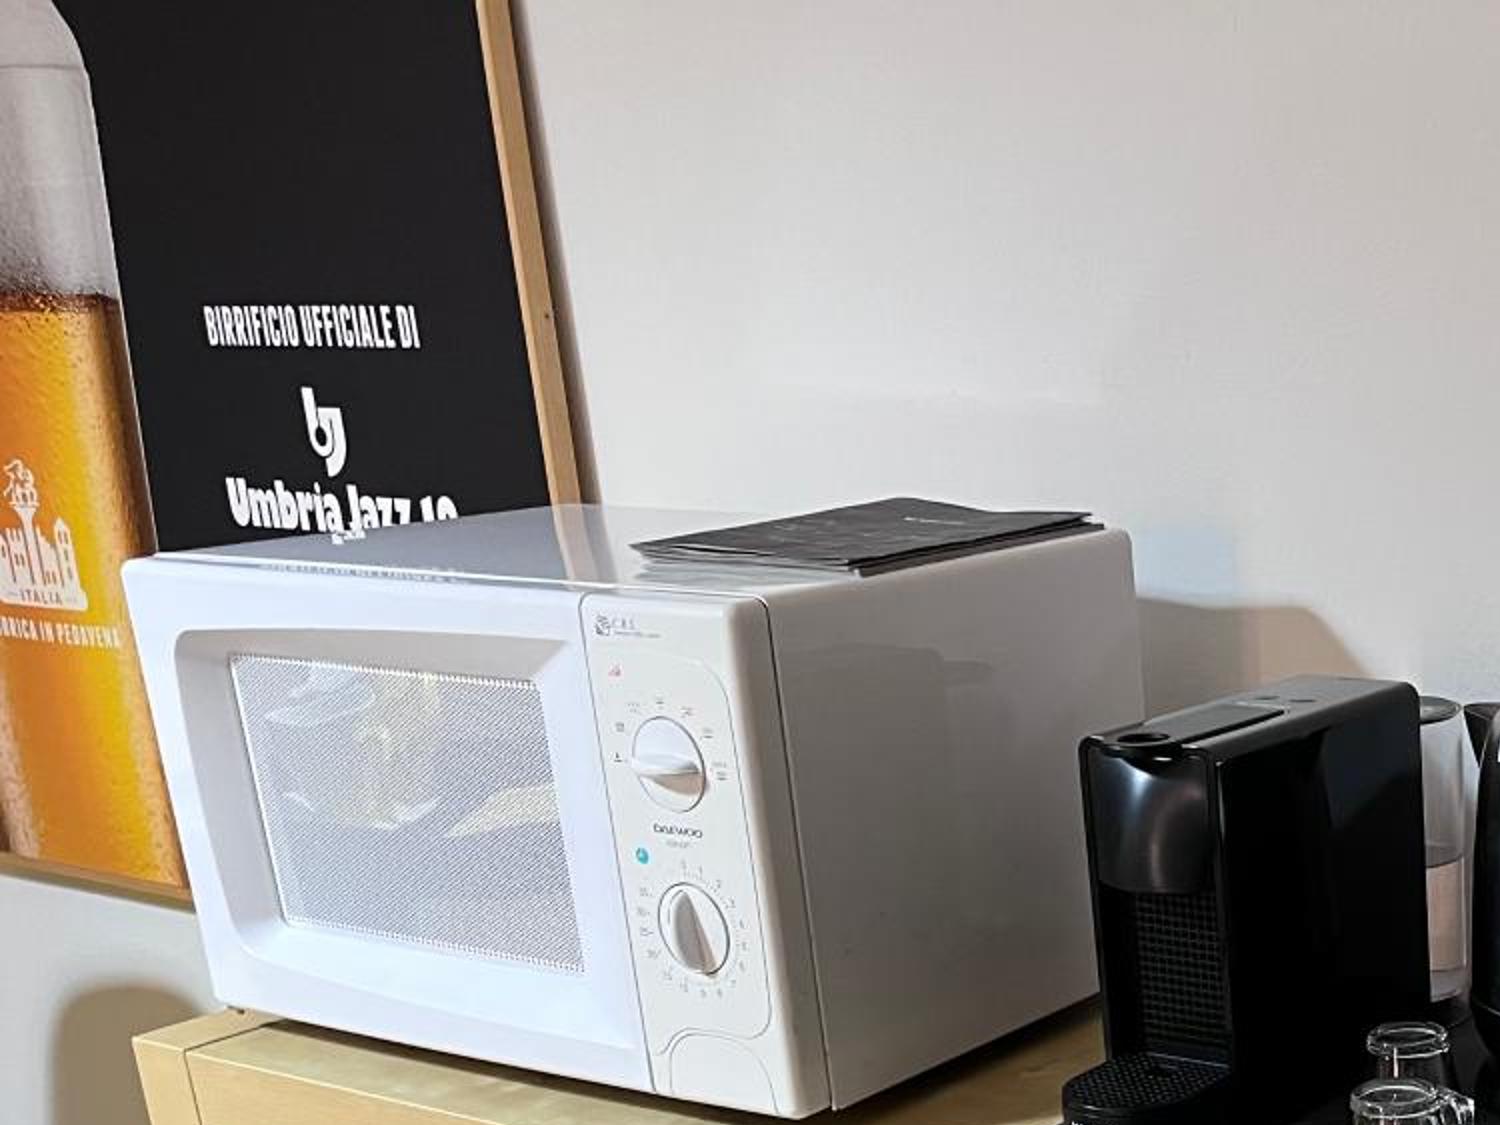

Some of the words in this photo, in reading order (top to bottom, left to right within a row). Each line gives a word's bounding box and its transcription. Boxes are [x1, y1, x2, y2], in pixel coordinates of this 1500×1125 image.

[203, 304, 299, 347] BIRRIFICIO
[299, 304, 397, 348] UFFICIALE
[395, 305, 421, 348] DI
[225, 477, 344, 532] Umbria
[345, 484, 411, 529] Jazz
[21, 588, 63, 606] ITALIA
